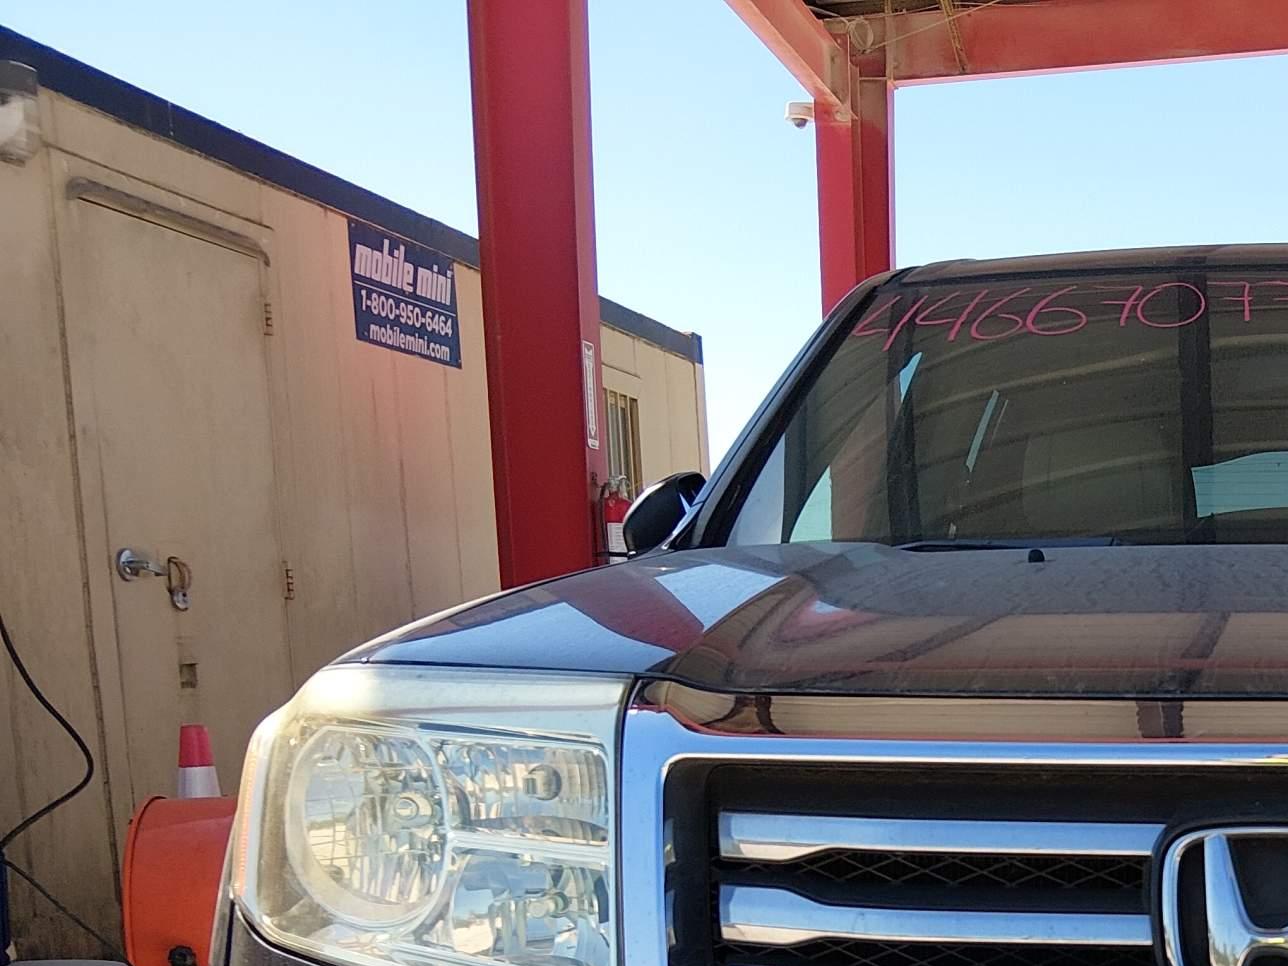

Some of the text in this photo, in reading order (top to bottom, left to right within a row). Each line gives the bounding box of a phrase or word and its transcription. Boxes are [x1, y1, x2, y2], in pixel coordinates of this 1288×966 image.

[355, 239, 452, 305] mobile mini
[361, 290, 452, 337] 1-800-950-6464
[370, 324, 449, 361] mobilemini.com
